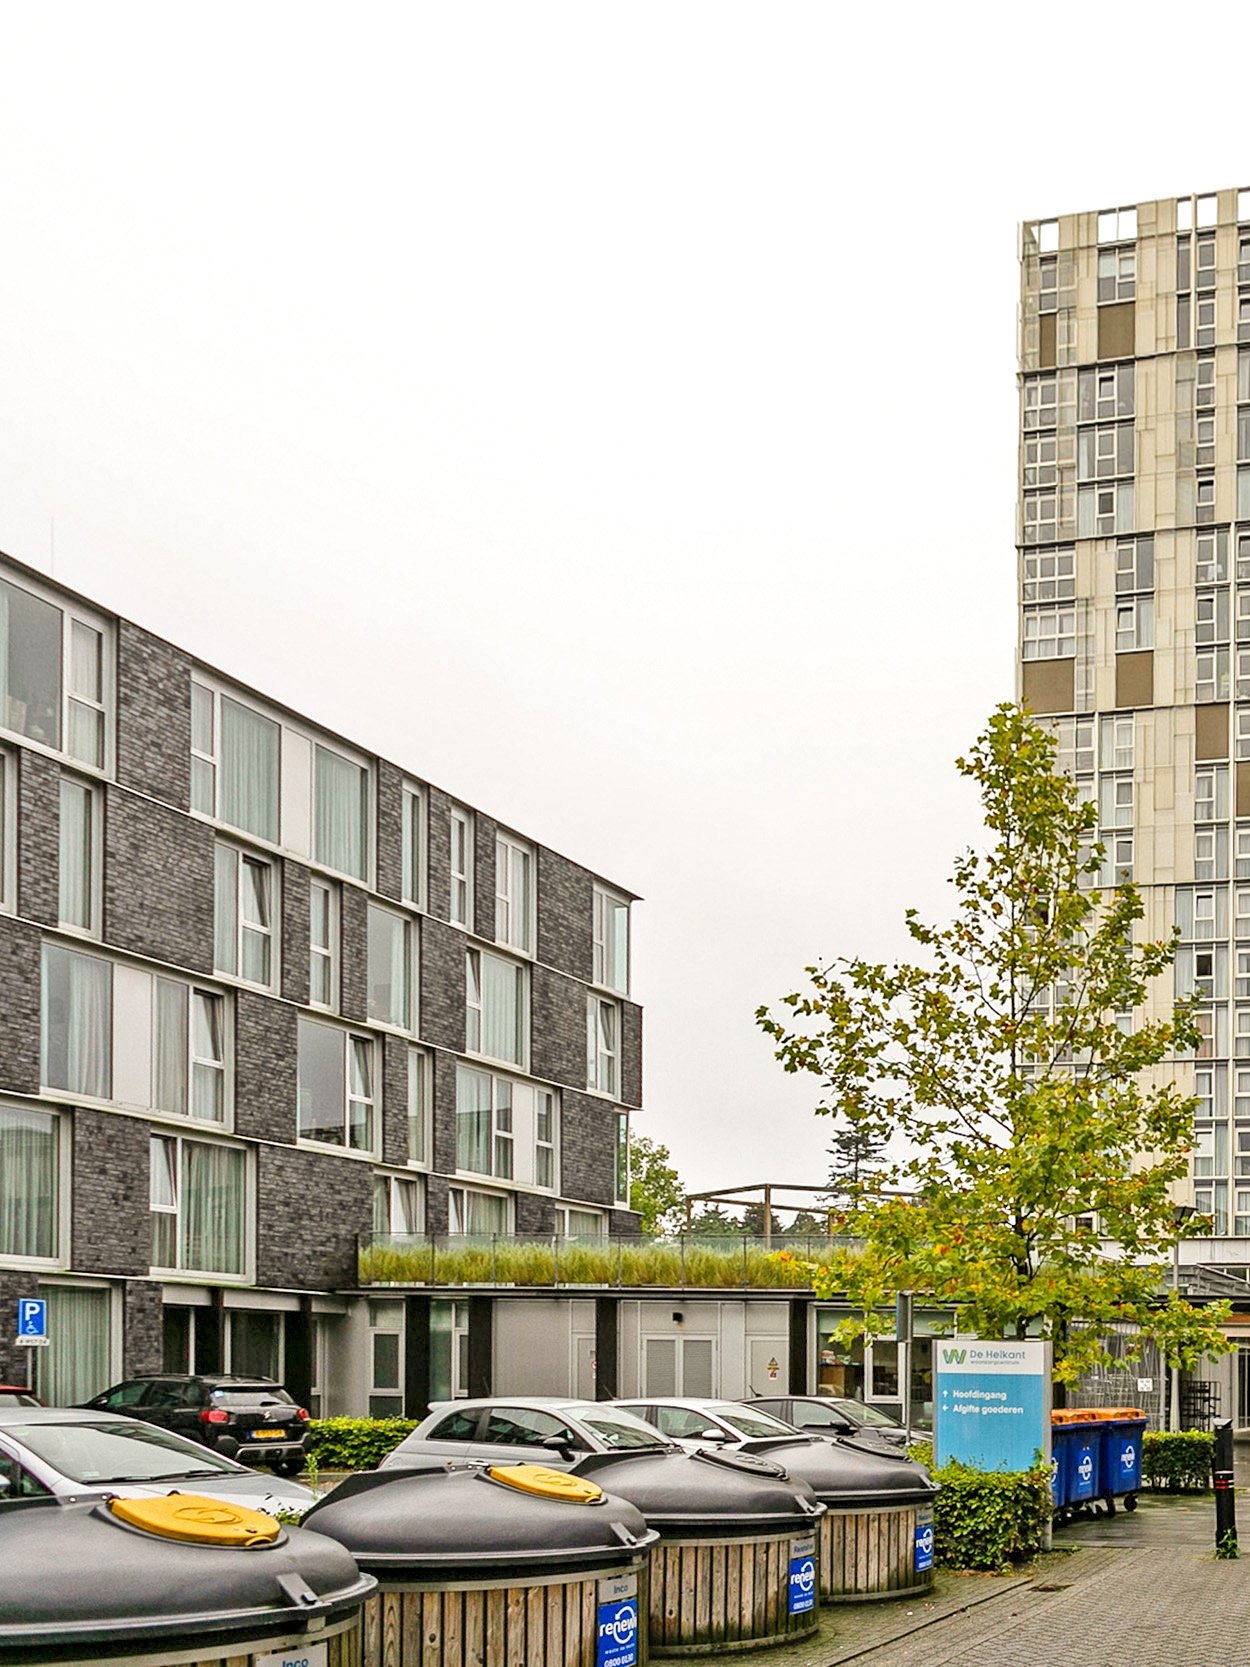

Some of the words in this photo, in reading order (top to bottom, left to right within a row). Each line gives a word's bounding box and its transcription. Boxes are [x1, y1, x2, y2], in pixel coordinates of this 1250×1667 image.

[25, 1302, 40, 1320] P
[970, 1350, 983, 1359] De
[985, 1350, 1026, 1359] Heikant
[952, 1390, 1007, 1401] Hoofdingang
[952, 1404, 980, 1415] Afgifte
[981, 1404, 1024, 1415] goederen
[613, 1584, 629, 1594] Inco
